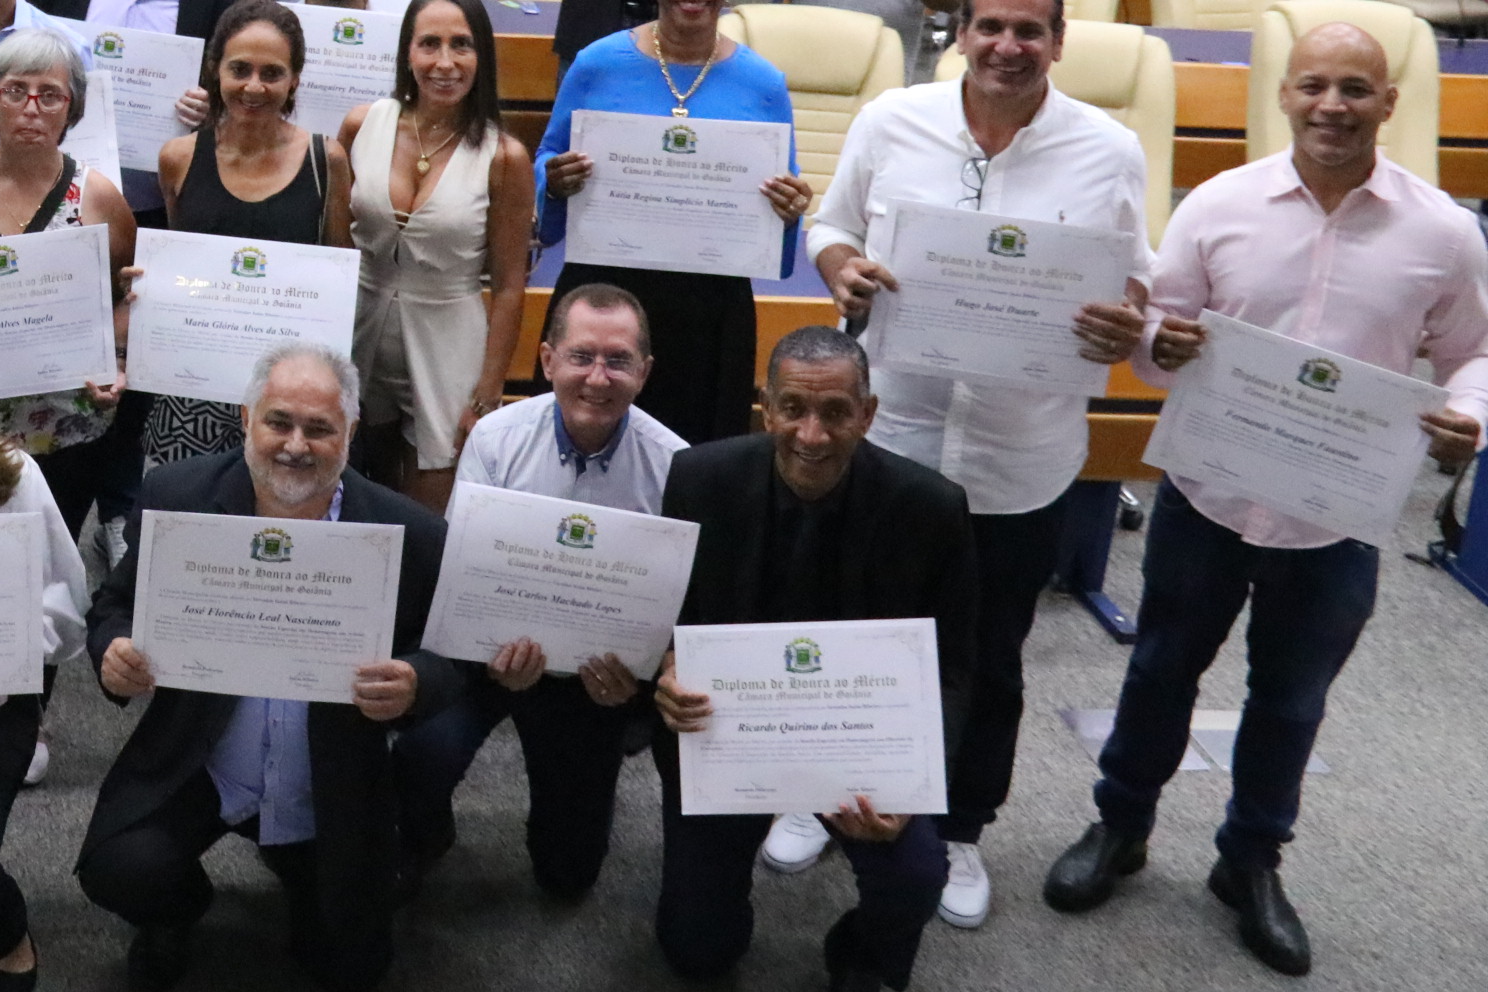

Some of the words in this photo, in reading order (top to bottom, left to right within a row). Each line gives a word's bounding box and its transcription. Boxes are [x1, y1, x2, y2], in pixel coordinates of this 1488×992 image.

[23, 314, 53, 326] Magela
[183, 317, 209, 329] Maria
[212, 320, 239, 331] Glória
[242, 323, 263, 334] Alves
[266, 325, 277, 335] da
[278, 327, 300, 338] Silva
[185, 560, 234, 576] Diploma
[238, 567, 250, 577] de
[255, 567, 291, 580] Honra
[295, 572, 308, 581] ao
[311, 571, 352, 585] Mérito
[494, 584, 515, 596] José
[518, 589, 547, 602] Carlos
[551, 594, 593, 609] Machado
[595, 601, 622, 614] Lopes
[182, 604, 205, 615] José
[207, 607, 255, 620] Florêncio
[259, 612, 281, 622] Leal
[284, 614, 341, 628] Nascimento
[712, 678, 766, 692] Diploma
[771, 679, 784, 690] de
[789, 677, 829, 689] Honra
[834, 679, 848, 688] ao
[853, 675, 897, 688] Mérito
[738, 721, 776, 732] Ricardo
[780, 721, 818, 733] Quirino
[821, 721, 837, 731] dos
[840, 720, 874, 730] Santos
